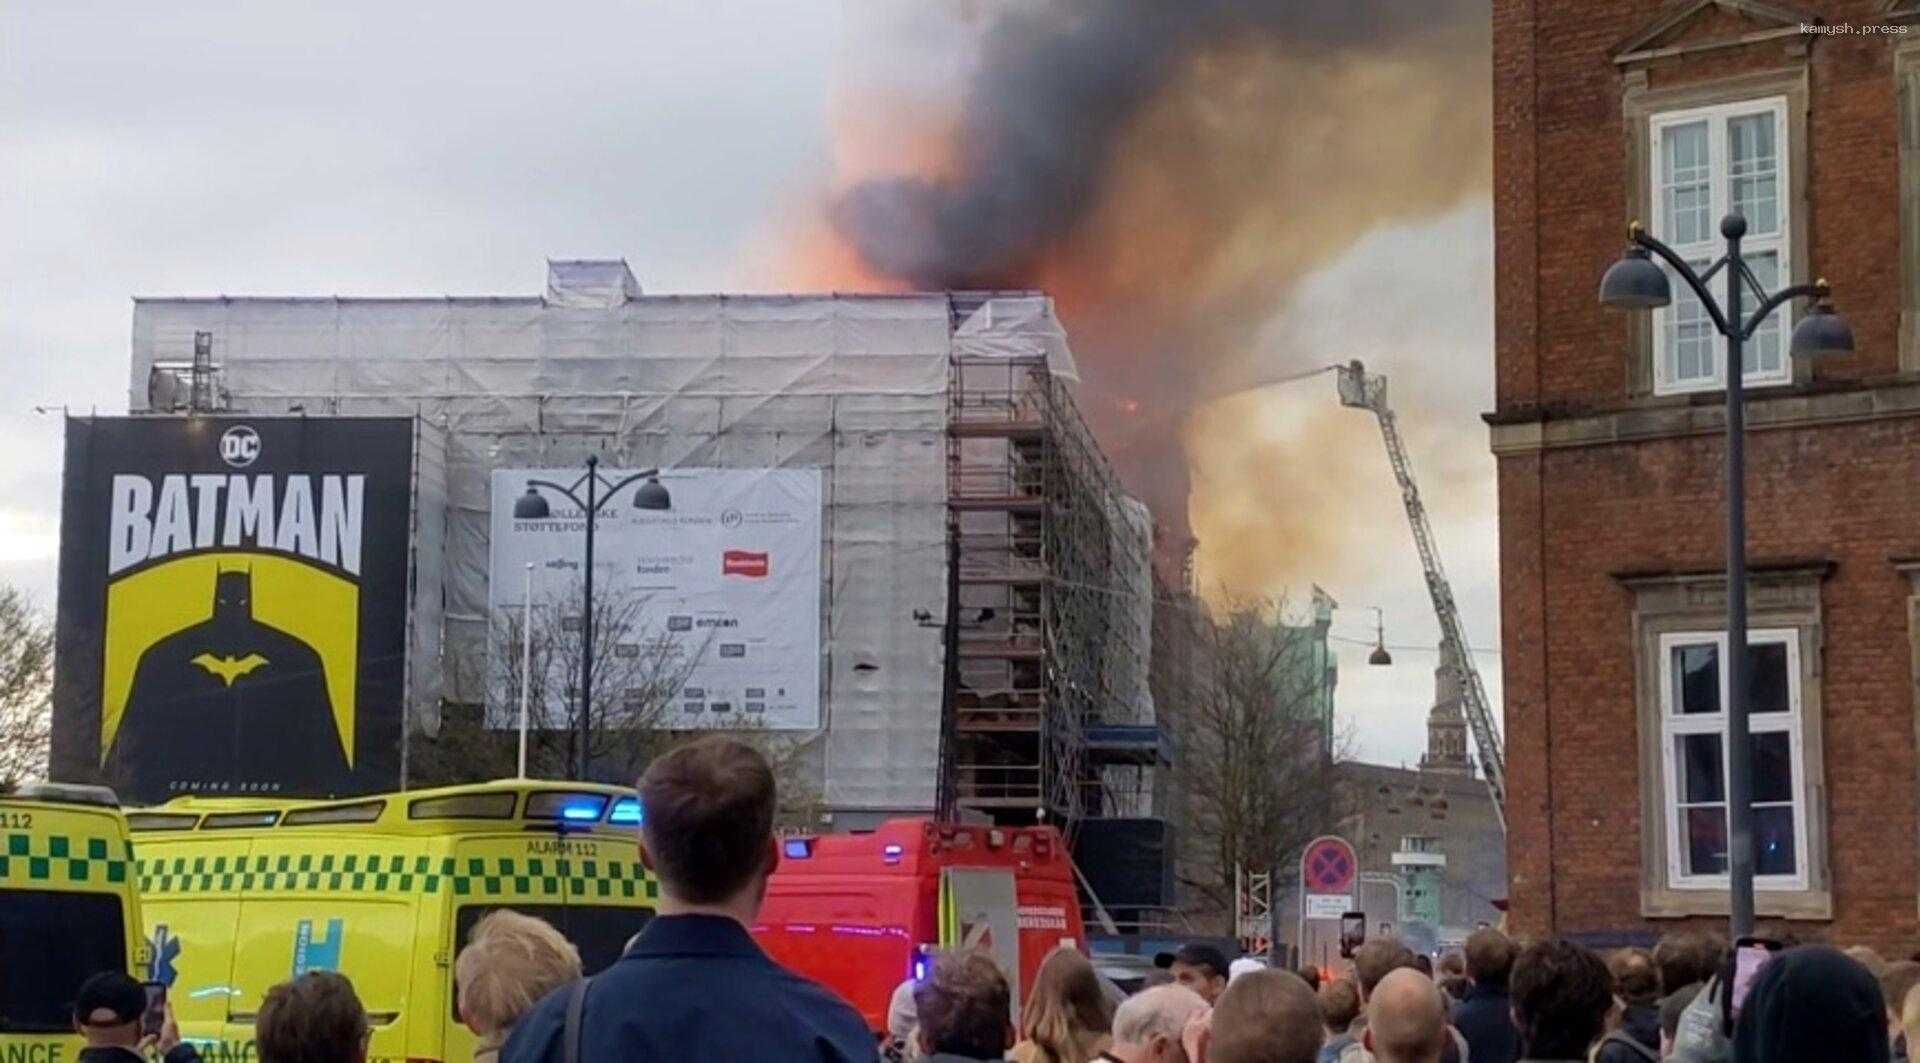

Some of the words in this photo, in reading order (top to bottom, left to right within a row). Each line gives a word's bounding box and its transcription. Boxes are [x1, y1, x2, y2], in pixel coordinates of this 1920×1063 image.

[223, 433, 259, 460] DC
[107, 474, 365, 577] BATMAN
[513, 521, 600, 533] STØTTEFOD
[169, 780, 231, 793] COMING
[240, 781, 281, 793] SOON
[0, 812, 33, 829] 112
[576, 842, 597, 856] 112
[0, 1042, 64, 1063] NCE
